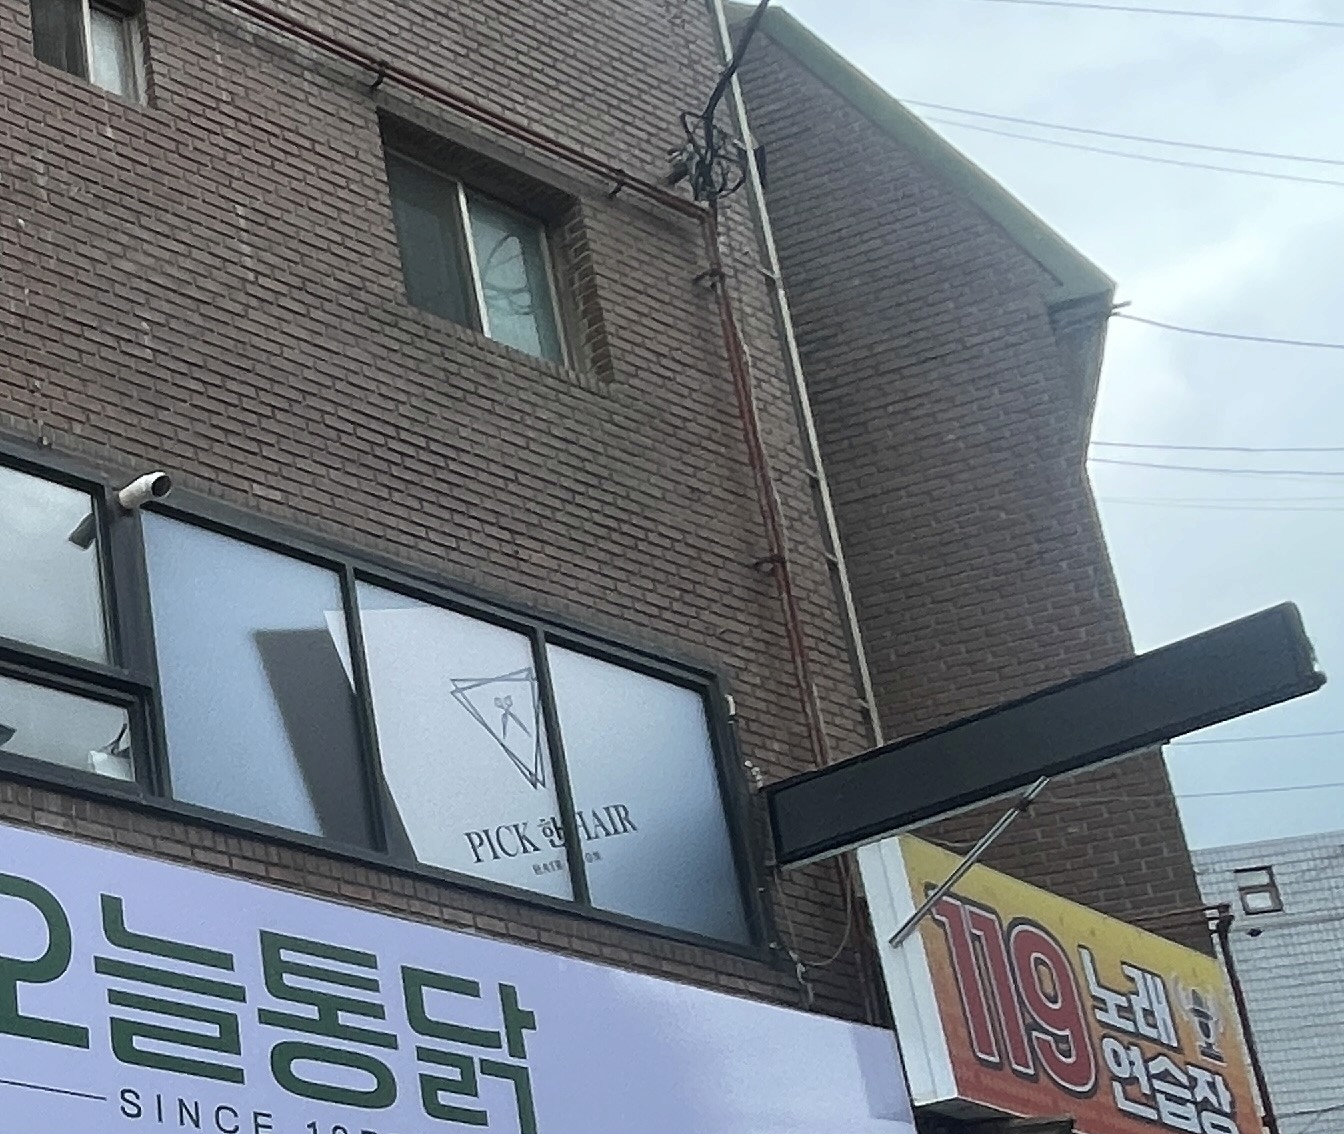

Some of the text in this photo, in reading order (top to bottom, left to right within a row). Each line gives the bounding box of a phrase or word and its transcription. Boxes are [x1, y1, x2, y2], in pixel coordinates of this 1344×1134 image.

[463, 821, 542, 864] PICK
[929, 894, 1180, 1095] 119 노래
